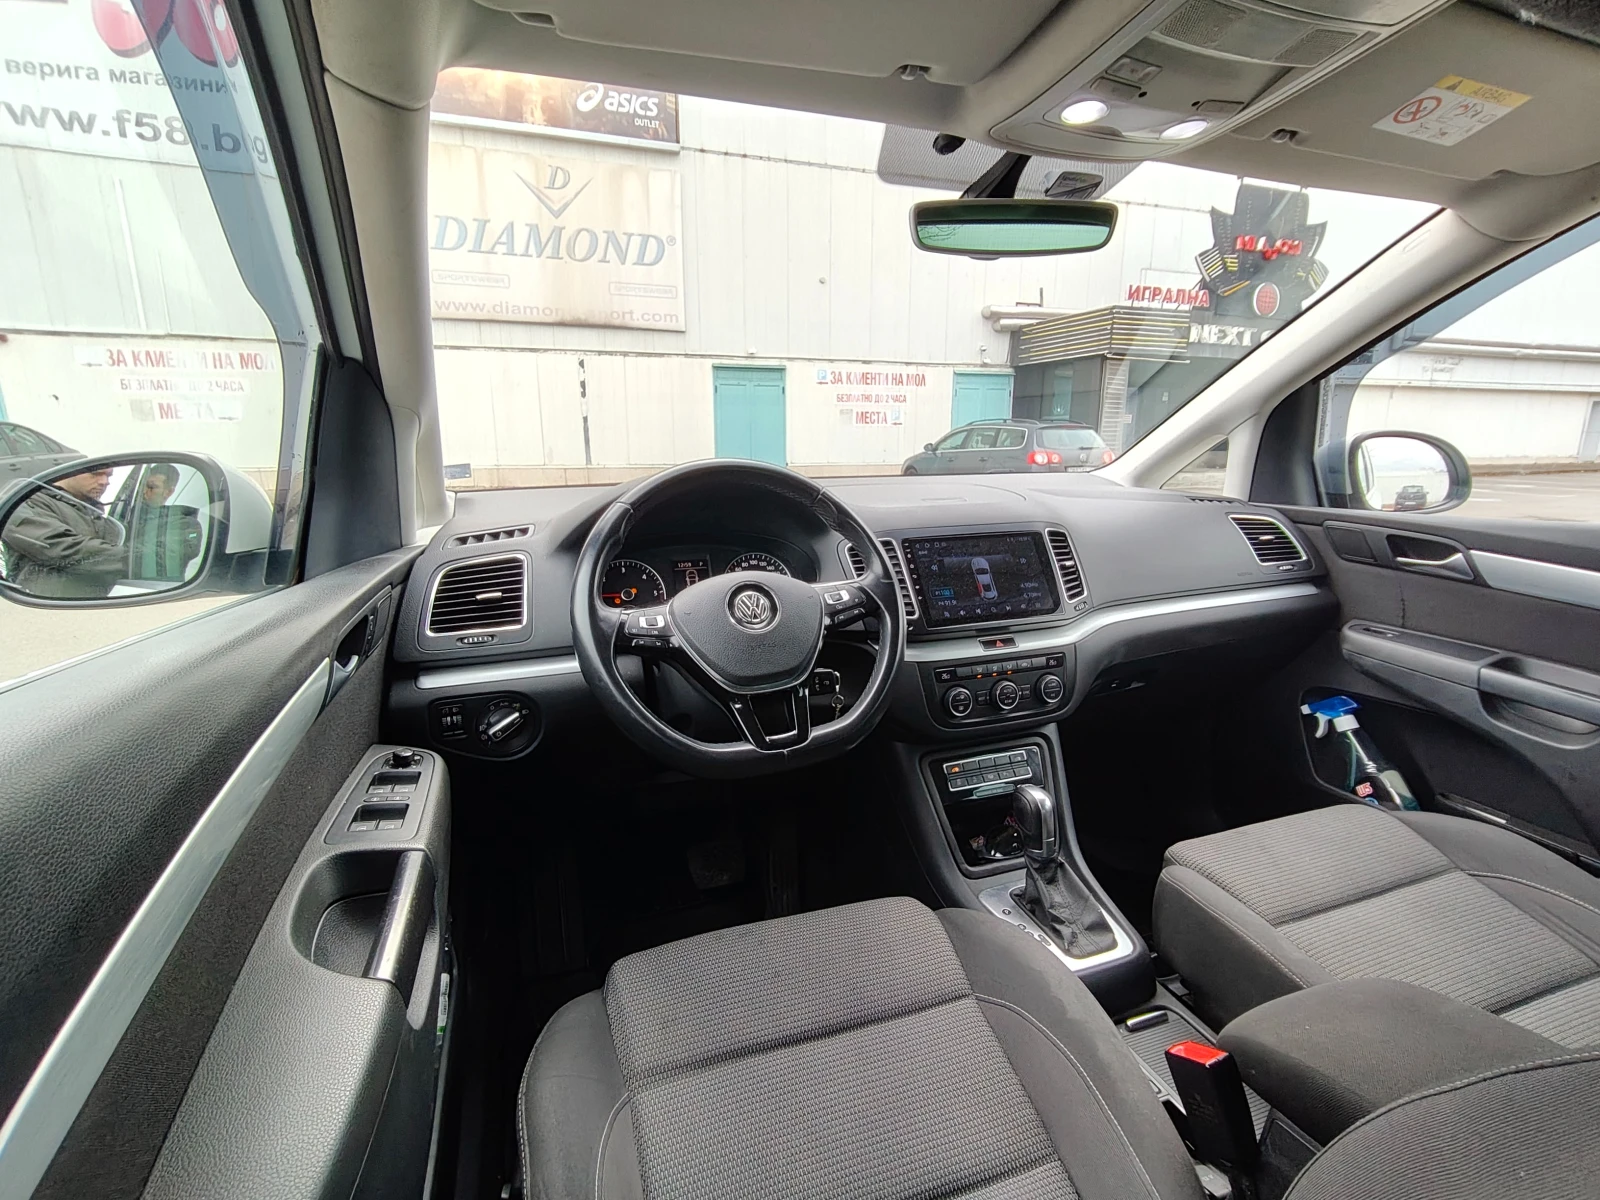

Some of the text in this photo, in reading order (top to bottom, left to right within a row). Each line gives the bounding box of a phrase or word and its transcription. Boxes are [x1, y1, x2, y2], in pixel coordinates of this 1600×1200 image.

[4, 58, 100, 82] верига
[603, 90, 660, 117] asics
[0, 101, 269, 164] ww.f58.bg
[634, 117, 660, 129] OUTLET
[543, 165, 571, 190] D
[1127, 284, 1210, 308] ИГРАЛНА
[434, 300, 680, 324] www.diamonport.com
[1189, 323, 1257, 347] NEXT
[106, 348, 128, 368] ЗА
[131, 349, 209, 370] КЛИЕИ
[212, 351, 236, 370] НА
[830, 371, 843, 385] ЗА
[891, 373, 904, 386] НА
[906, 373, 926, 387] МОЛ
[158, 402, 215, 420] МЕТА
[855, 411, 888, 424] МЕСТА
